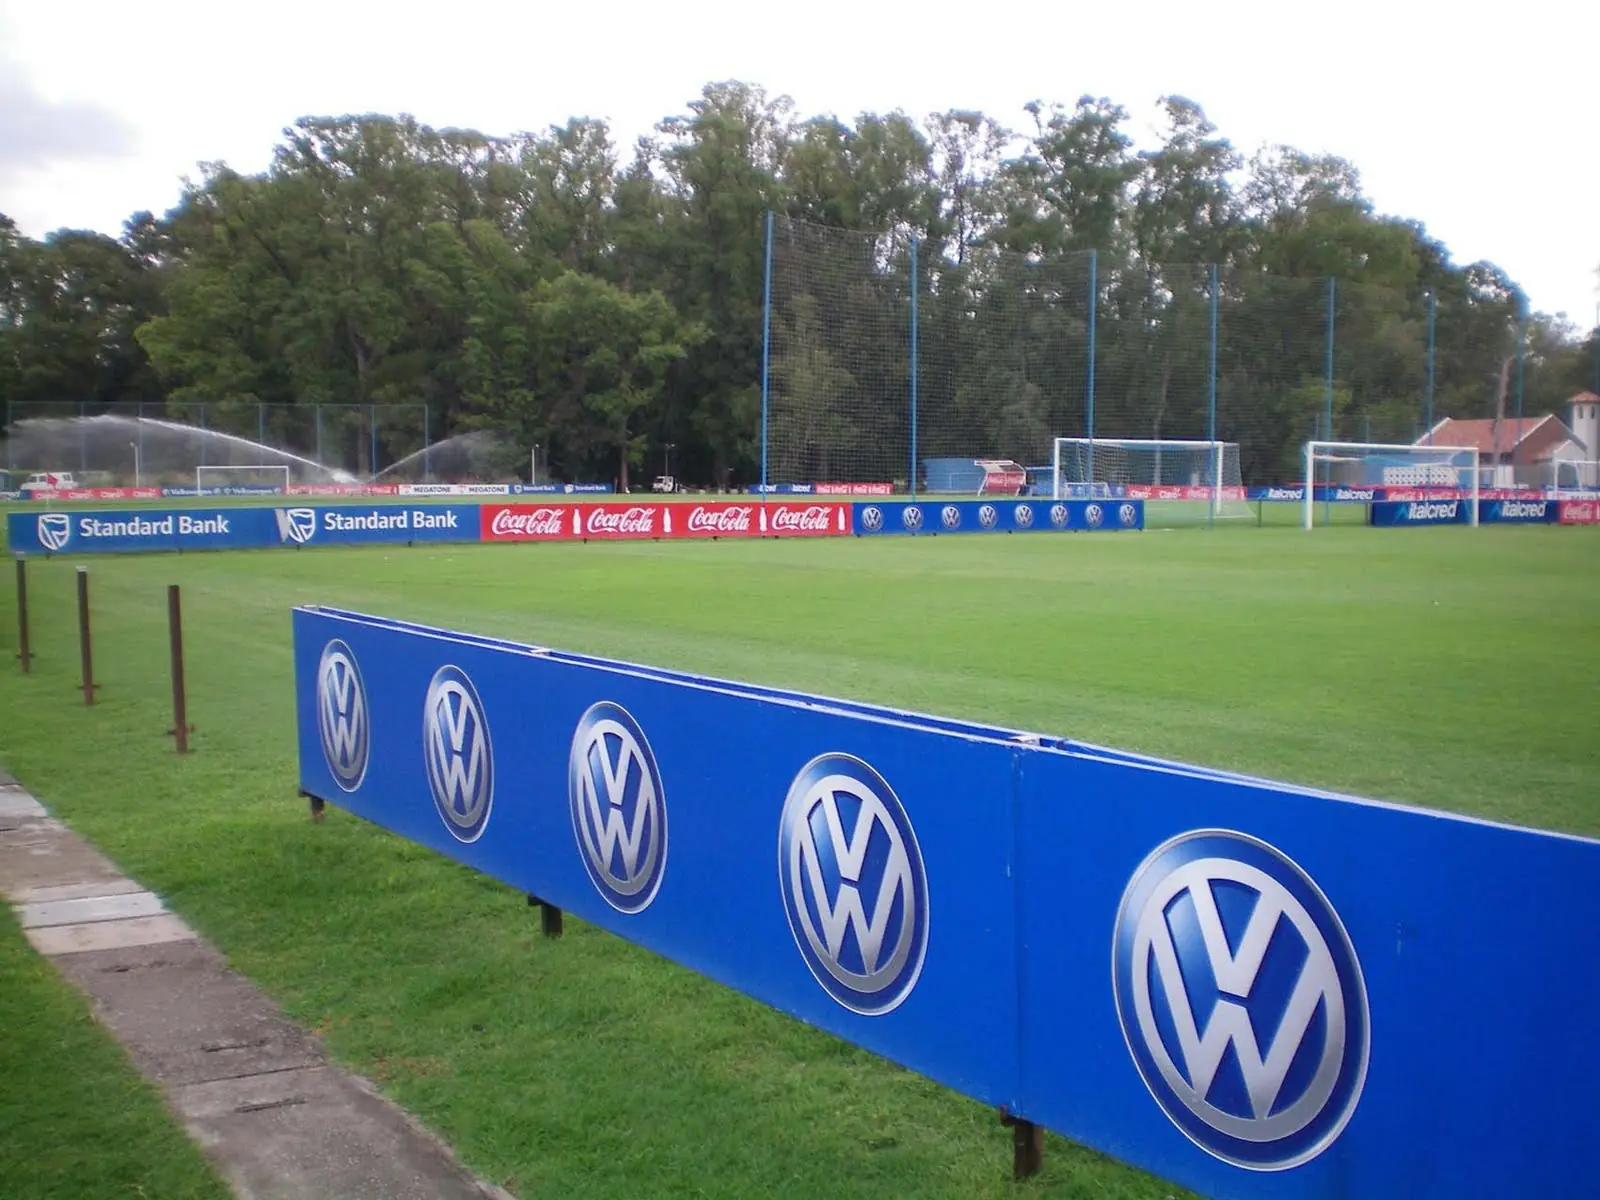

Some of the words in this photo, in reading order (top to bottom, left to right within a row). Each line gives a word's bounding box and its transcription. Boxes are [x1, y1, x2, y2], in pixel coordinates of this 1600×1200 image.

[79, 516, 173, 537] Standard
[178, 515, 229, 534] Bank
[324, 511, 408, 531] Standard
[412, 510, 458, 528] Bank
